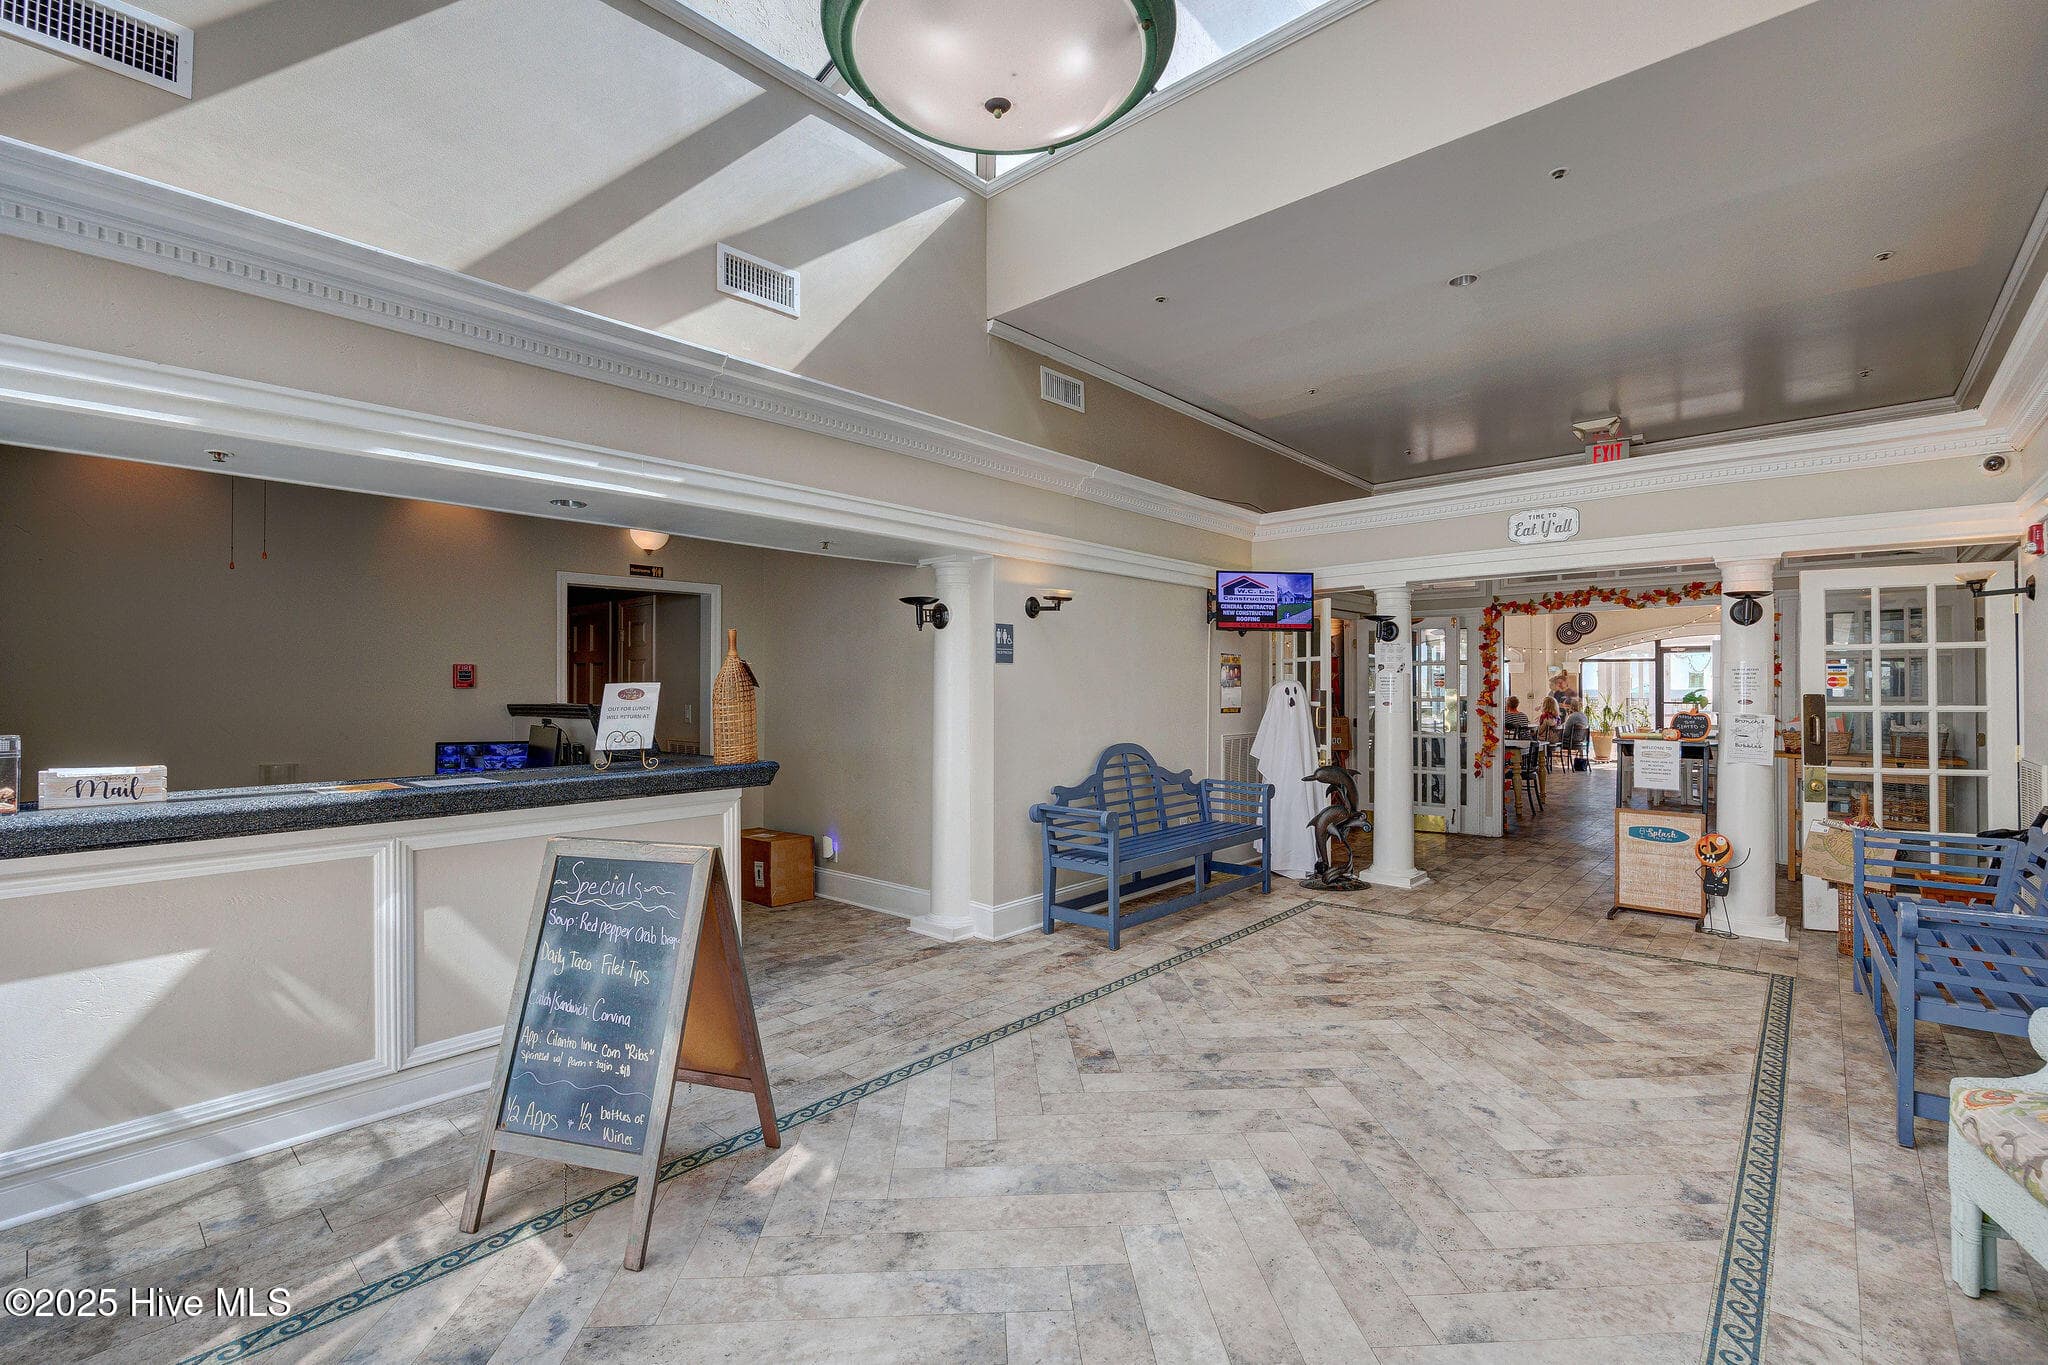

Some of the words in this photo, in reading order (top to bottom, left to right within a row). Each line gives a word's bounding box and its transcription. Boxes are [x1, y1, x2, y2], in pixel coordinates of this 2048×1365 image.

[1593, 442, 1622, 464] EXIT
[1514, 522, 1538, 537] Eat
[1541, 518, 1573, 538] Y'all
[65, 776, 145, 800] Mail
[565, 860, 643, 904] Specials
[549, 908, 579, 932] Soup:
[580, 911, 598, 932] Red
[598, 919, 635, 944] pepper
[541, 940, 566, 976] Daily
[601, 953, 625, 976] Filet
[629, 960, 650, 987] Tips
[522, 1101, 559, 1133] Apps
[600, 1105, 632, 1124] bottles
[634, 1114, 646, 1126] of
